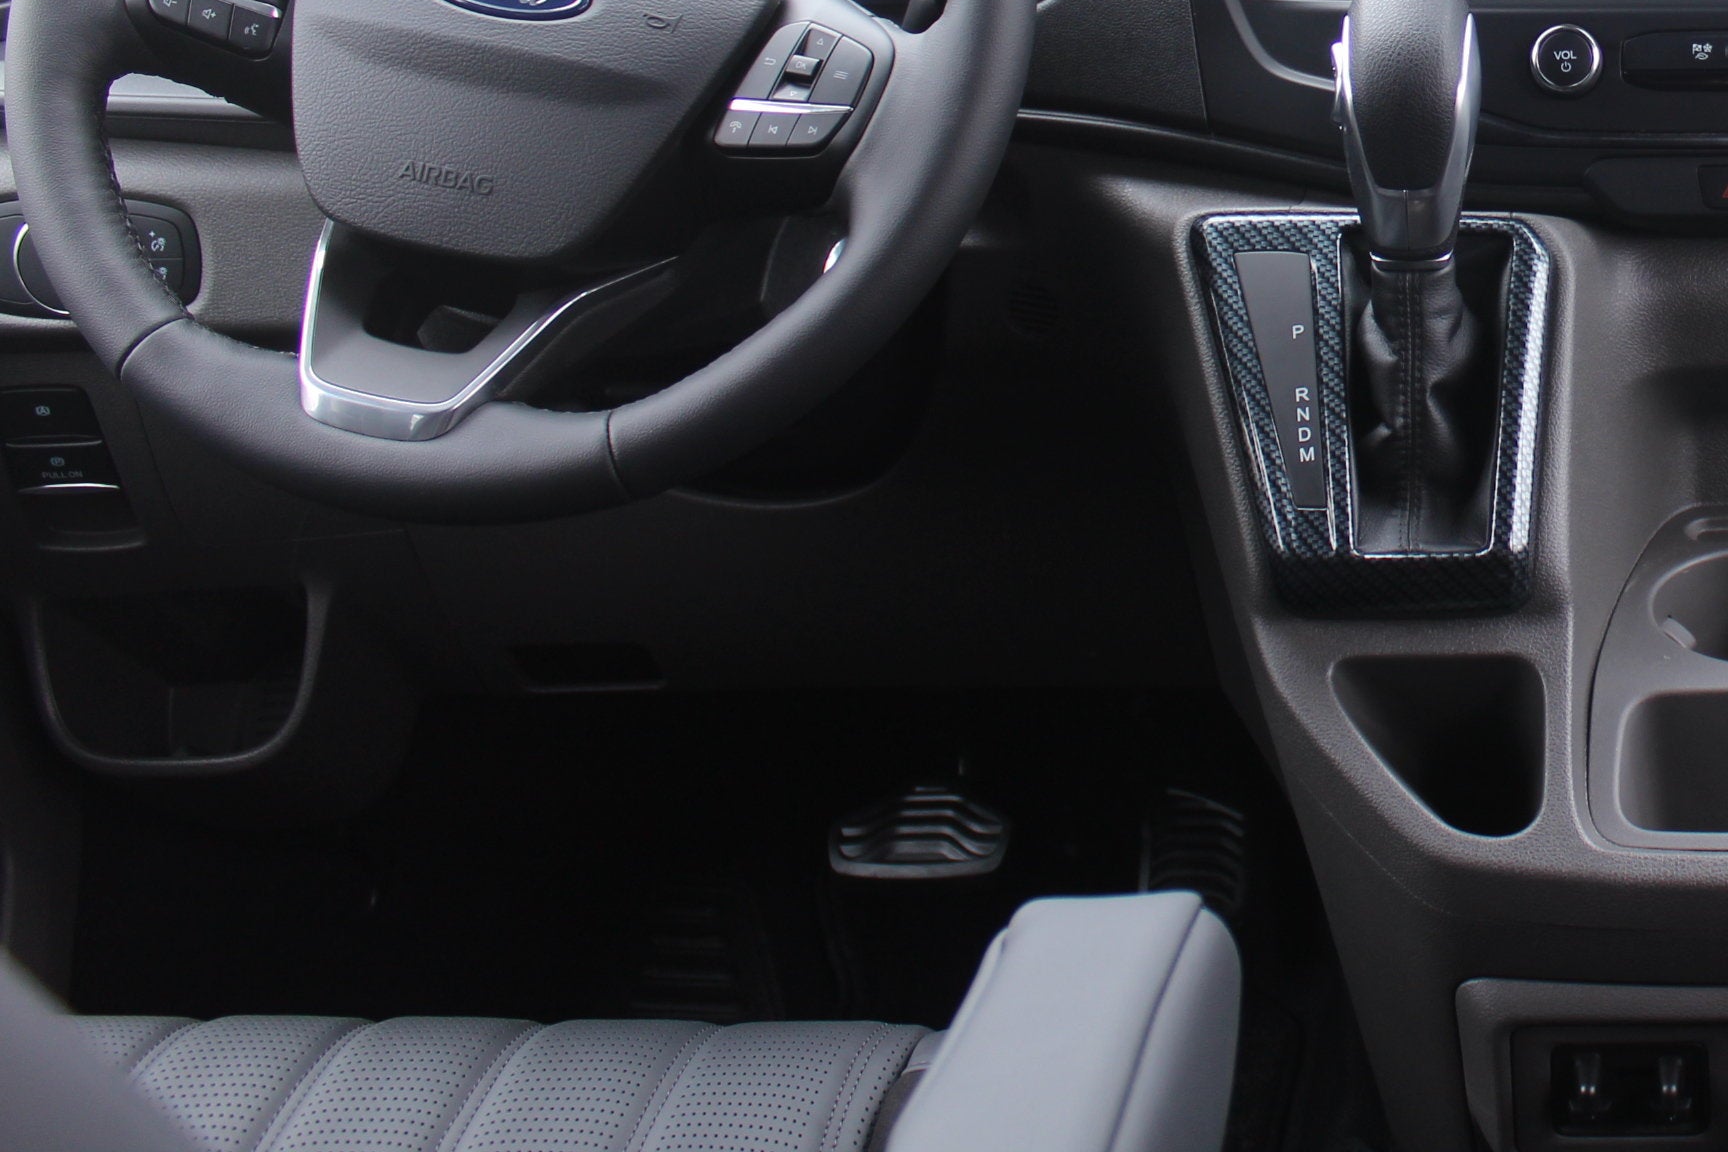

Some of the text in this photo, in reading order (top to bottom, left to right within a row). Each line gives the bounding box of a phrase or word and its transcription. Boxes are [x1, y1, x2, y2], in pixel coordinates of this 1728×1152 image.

[1553, 50, 1577, 61] VOL
[399, 159, 494, 196] AIRBAG
[1292, 324, 1305, 340] P
[1295, 387, 1310, 402] R
[1296, 407, 1311, 422] N
[1298, 426, 1312, 442] D
[1299, 447, 1315, 463] M
